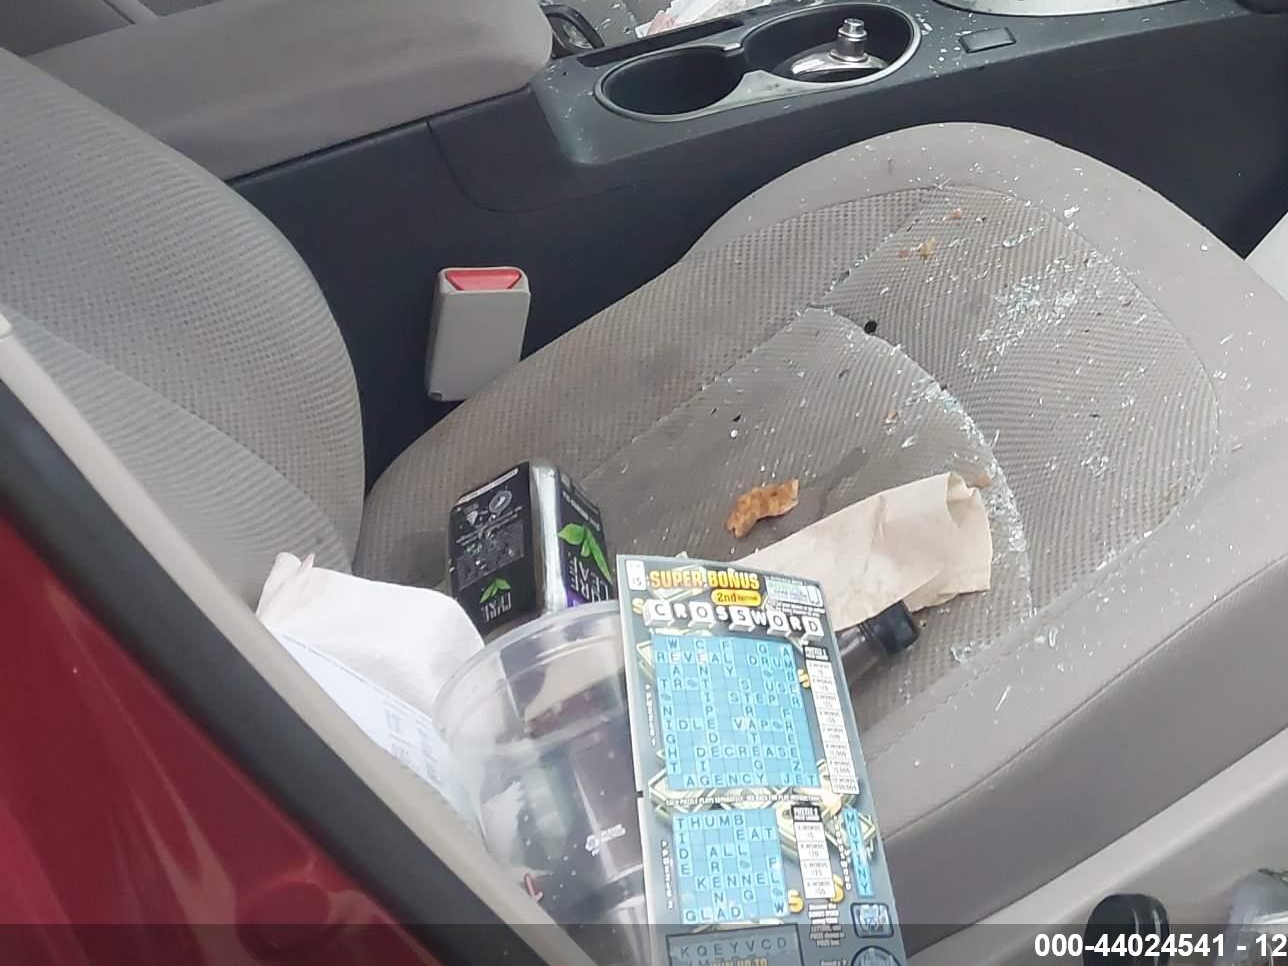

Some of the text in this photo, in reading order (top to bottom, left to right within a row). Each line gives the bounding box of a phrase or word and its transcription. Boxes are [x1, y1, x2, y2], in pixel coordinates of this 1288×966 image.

[651, 568, 760, 589] SUPER BONUS
[717, 591, 737, 603] 2nd
[652, 601, 821, 634] CROSSWORD
[697, 746, 800, 758] DECREASE
[687, 774, 765, 786] AGENCY
[676, 814, 744, 829] THUMB
[697, 874, 779, 889] KENNEL
[685, 905, 741, 920] GLAD
